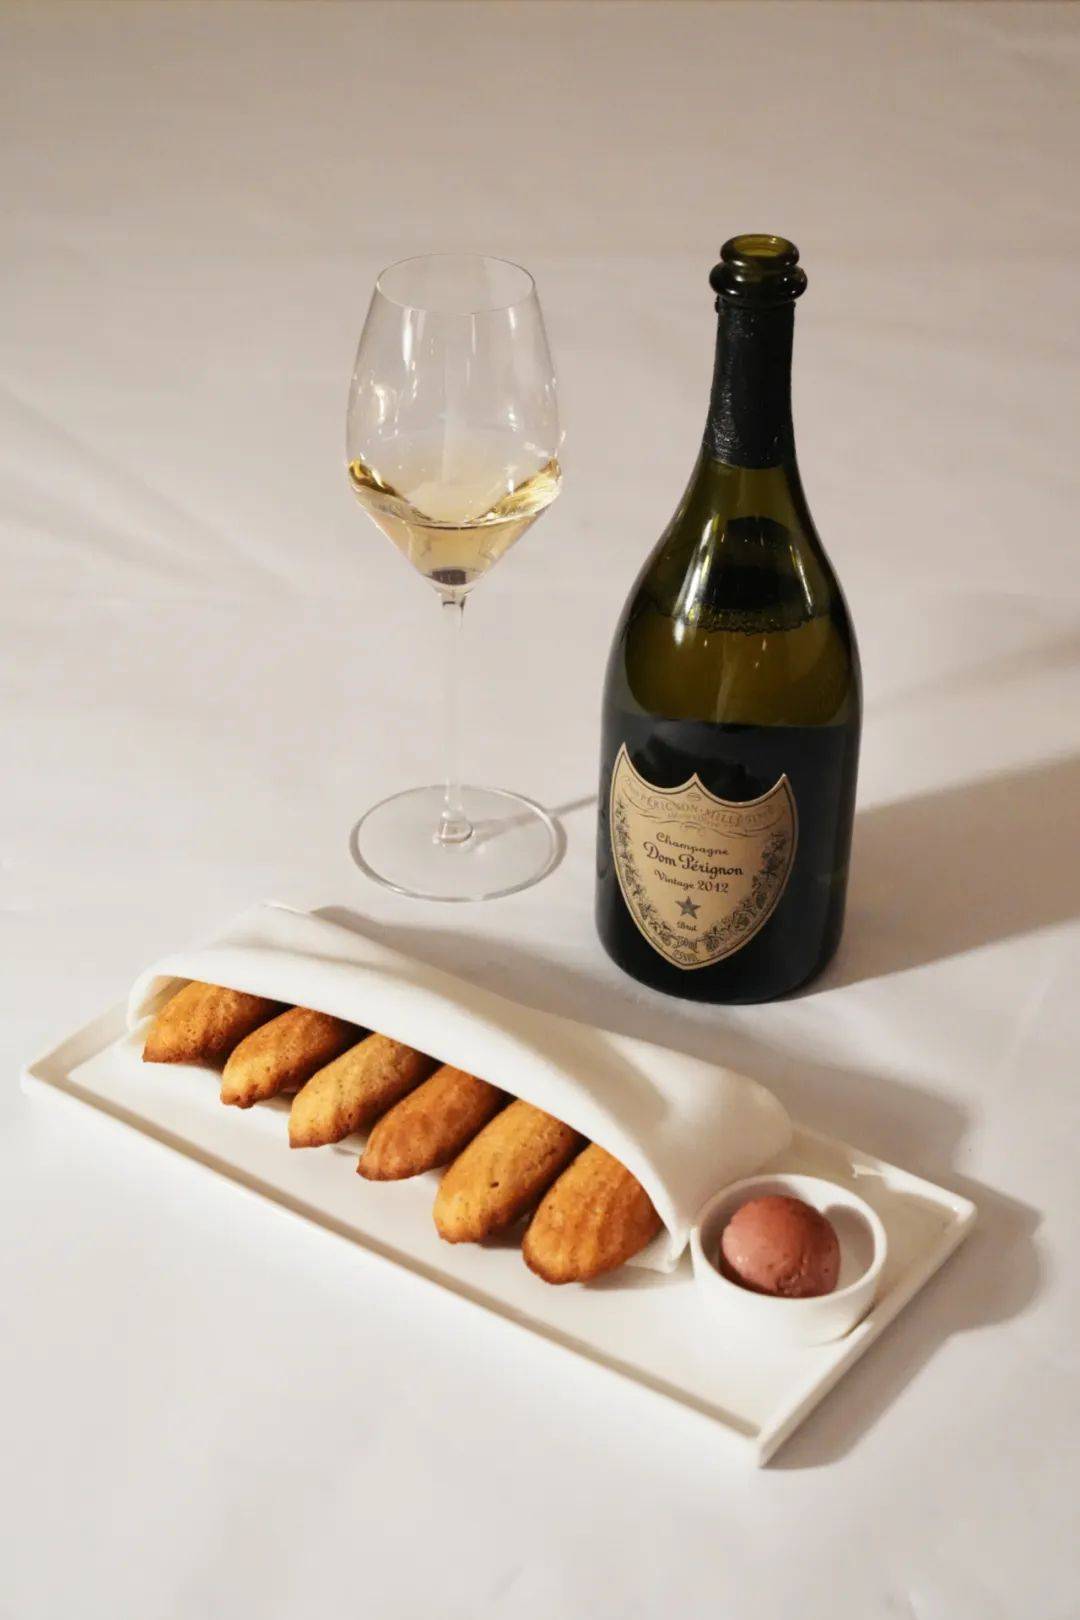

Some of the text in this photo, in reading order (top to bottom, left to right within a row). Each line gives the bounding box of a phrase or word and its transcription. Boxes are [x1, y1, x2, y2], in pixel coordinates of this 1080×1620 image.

[656, 831, 729, 857] Champagne
[643, 841, 744, 879] Dom Pérignon
[654, 868, 729, 893] Vintage 2012
